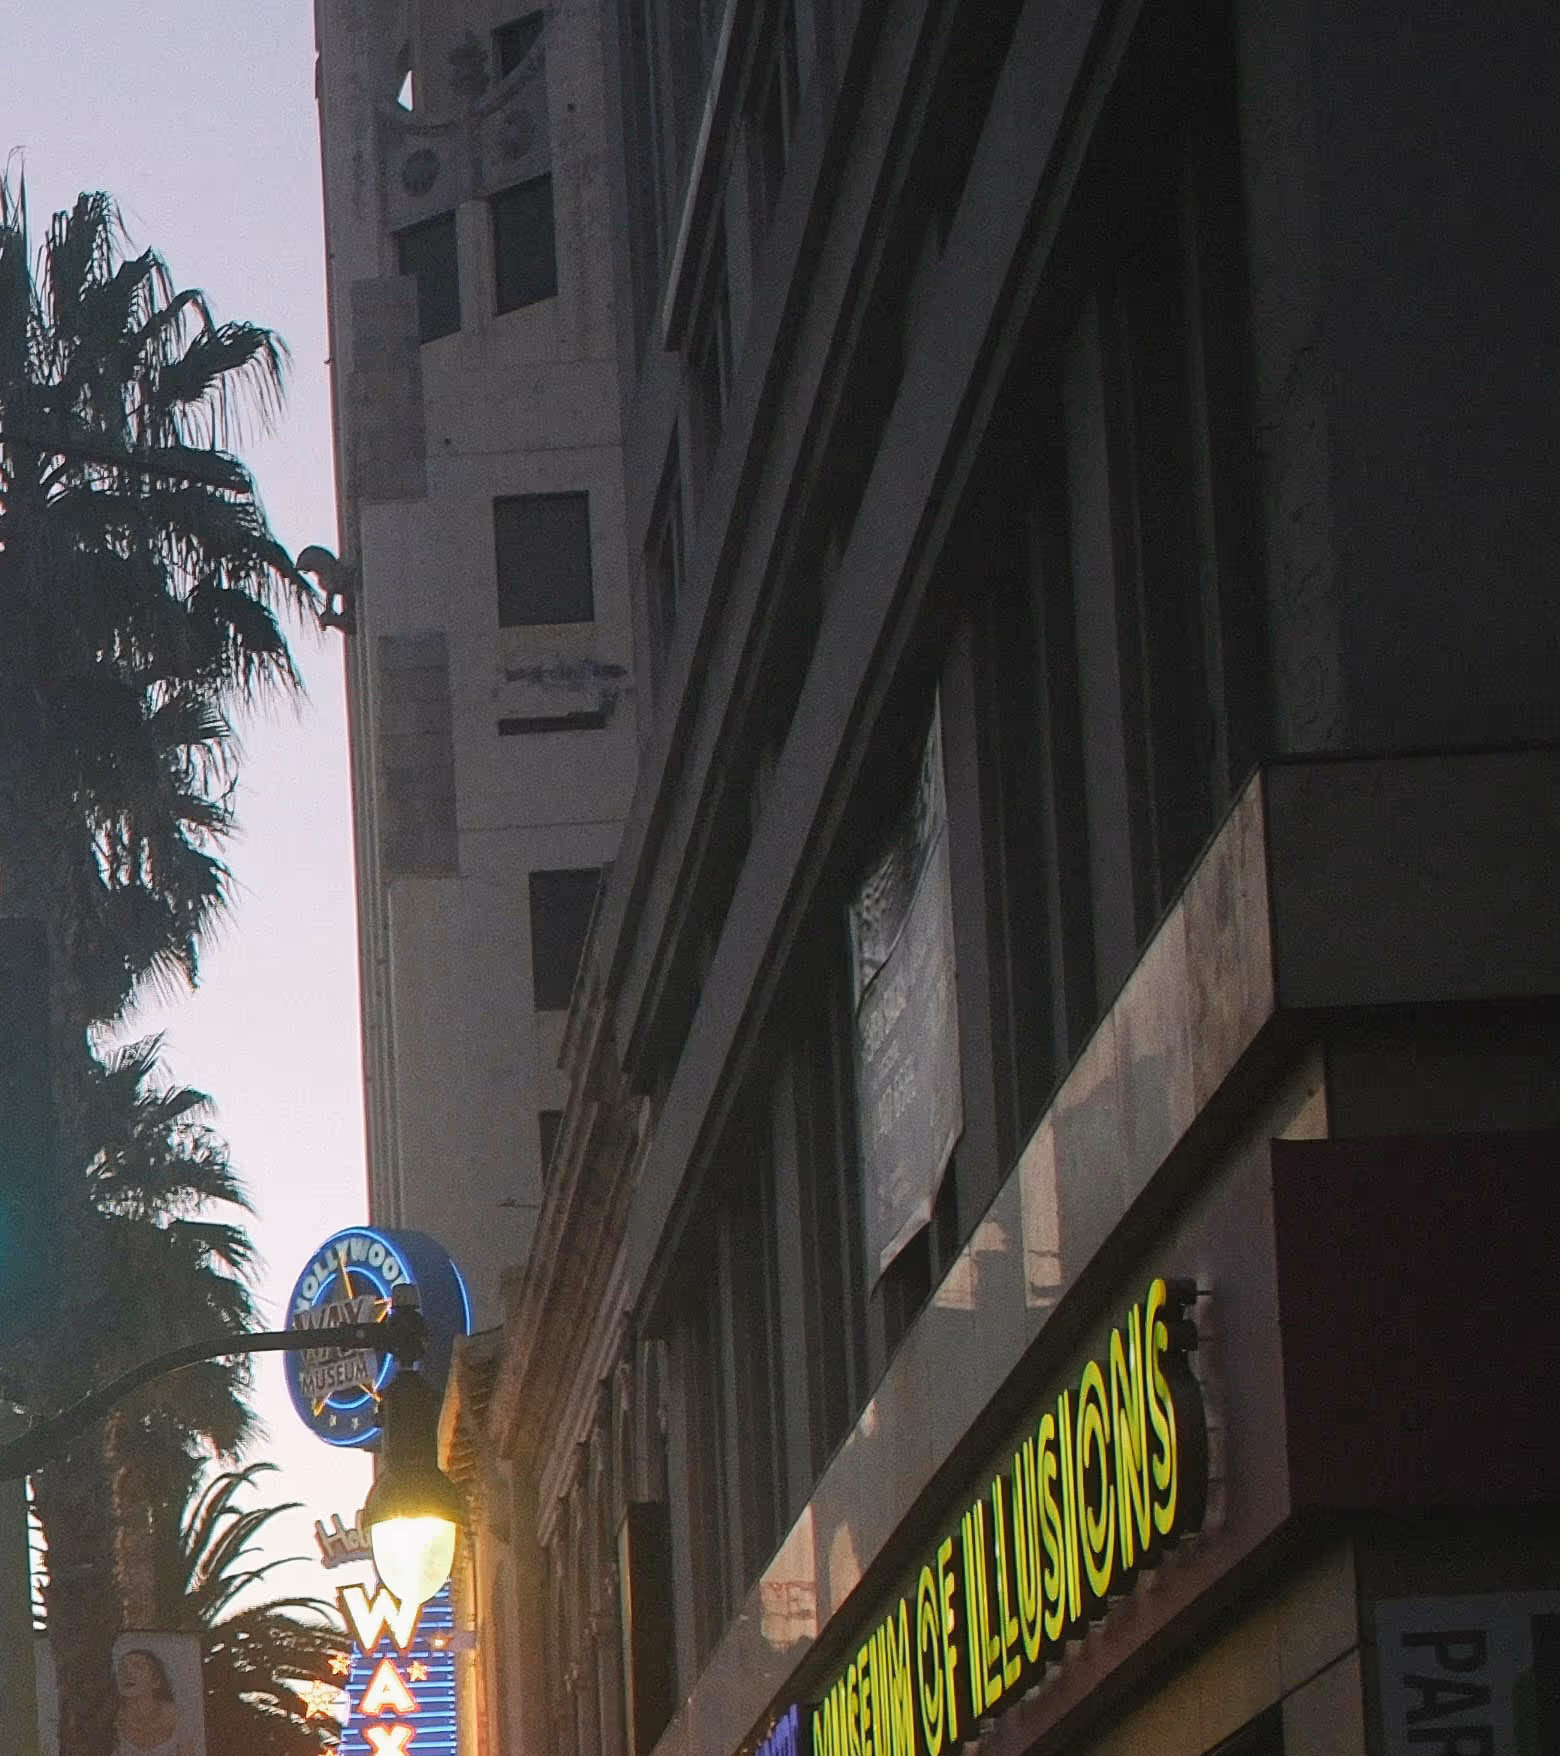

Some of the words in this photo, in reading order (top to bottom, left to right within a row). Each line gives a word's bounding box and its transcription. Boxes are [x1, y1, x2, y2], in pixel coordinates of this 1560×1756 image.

[296, 1237, 406, 1312] HOLLYWOO
[302, 1360, 369, 1394] MUSEUM
[961, 1278, 1180, 1719] ILLUSIONS
